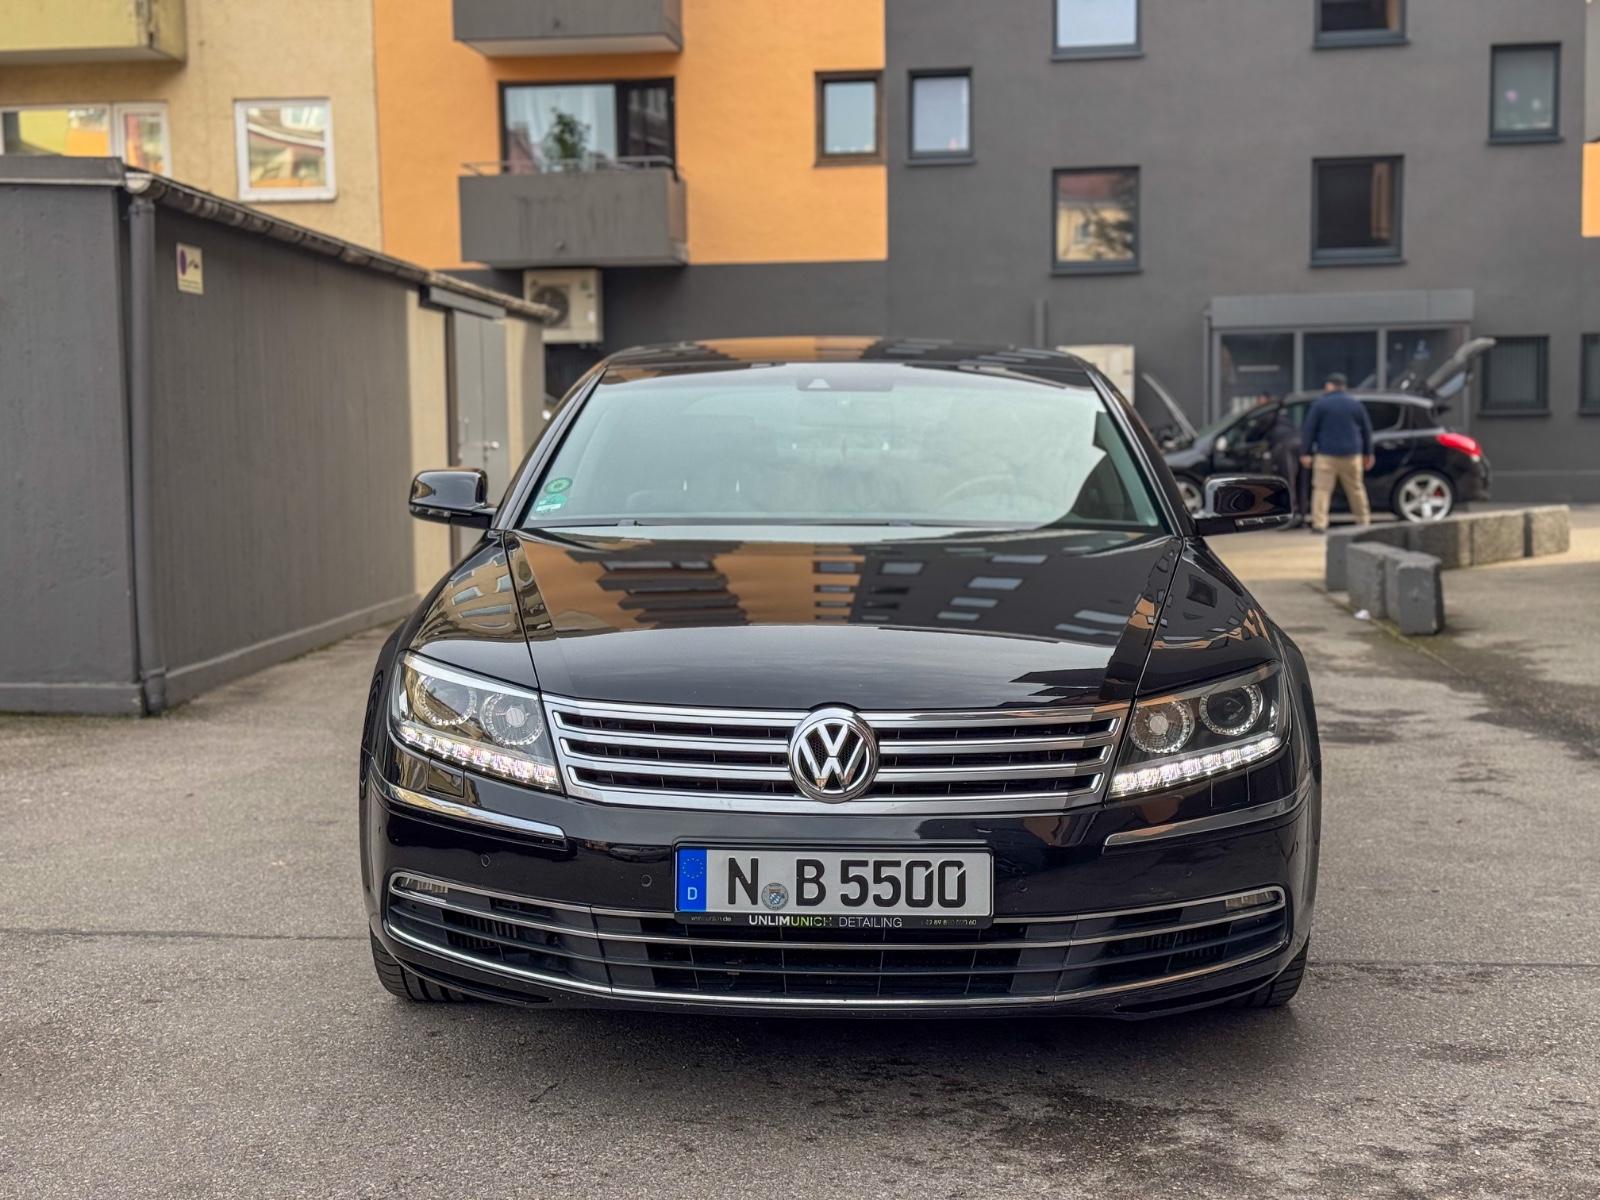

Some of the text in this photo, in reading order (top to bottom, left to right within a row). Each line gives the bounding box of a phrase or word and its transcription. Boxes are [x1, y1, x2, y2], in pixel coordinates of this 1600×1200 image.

[799, 721, 865, 792] VW
[687, 886, 698, 901] D
[727, 857, 759, 906] N
[795, 858, 827, 907] B
[840, 859, 967, 908] 5500
[838, 916, 903, 928] DETAILING
